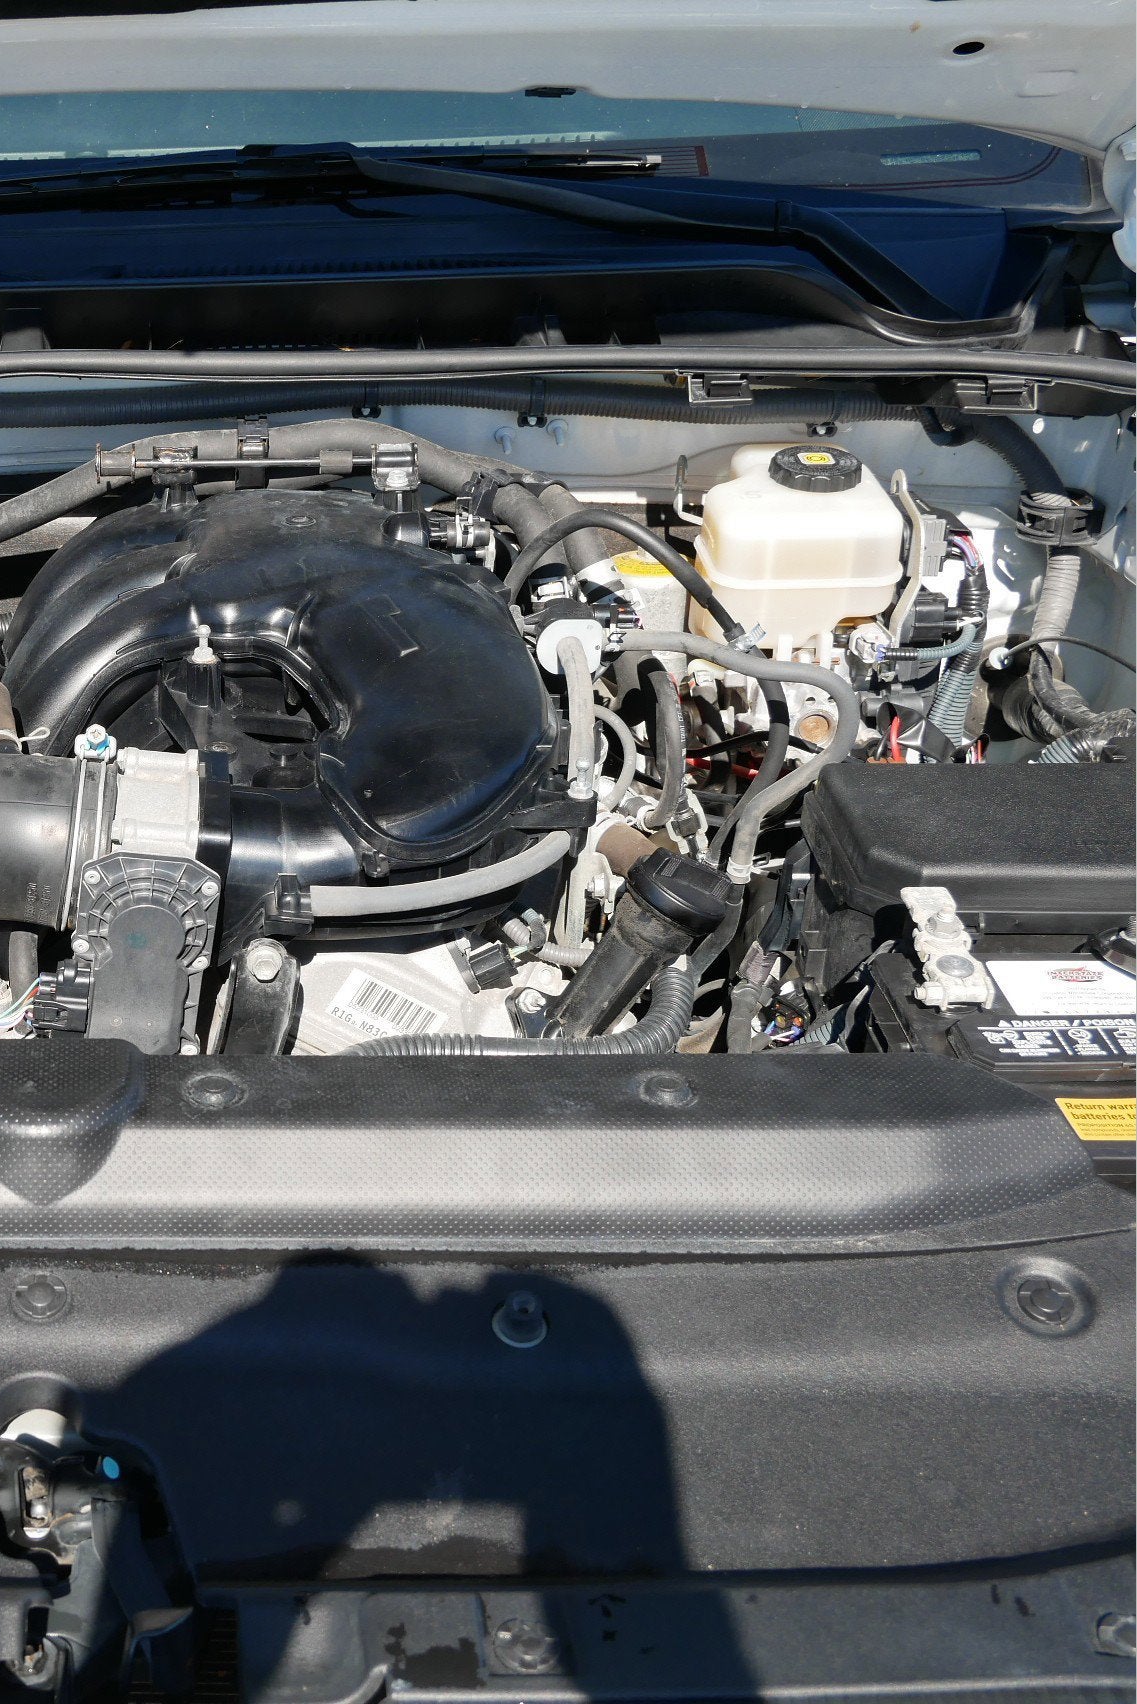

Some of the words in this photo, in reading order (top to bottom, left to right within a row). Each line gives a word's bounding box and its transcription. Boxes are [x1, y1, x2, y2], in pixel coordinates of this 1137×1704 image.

[1082, 1018, 1136, 1026] POISON
[1065, 1102, 1105, 1110] Return
[1070, 1112, 1126, 1120] batteries
